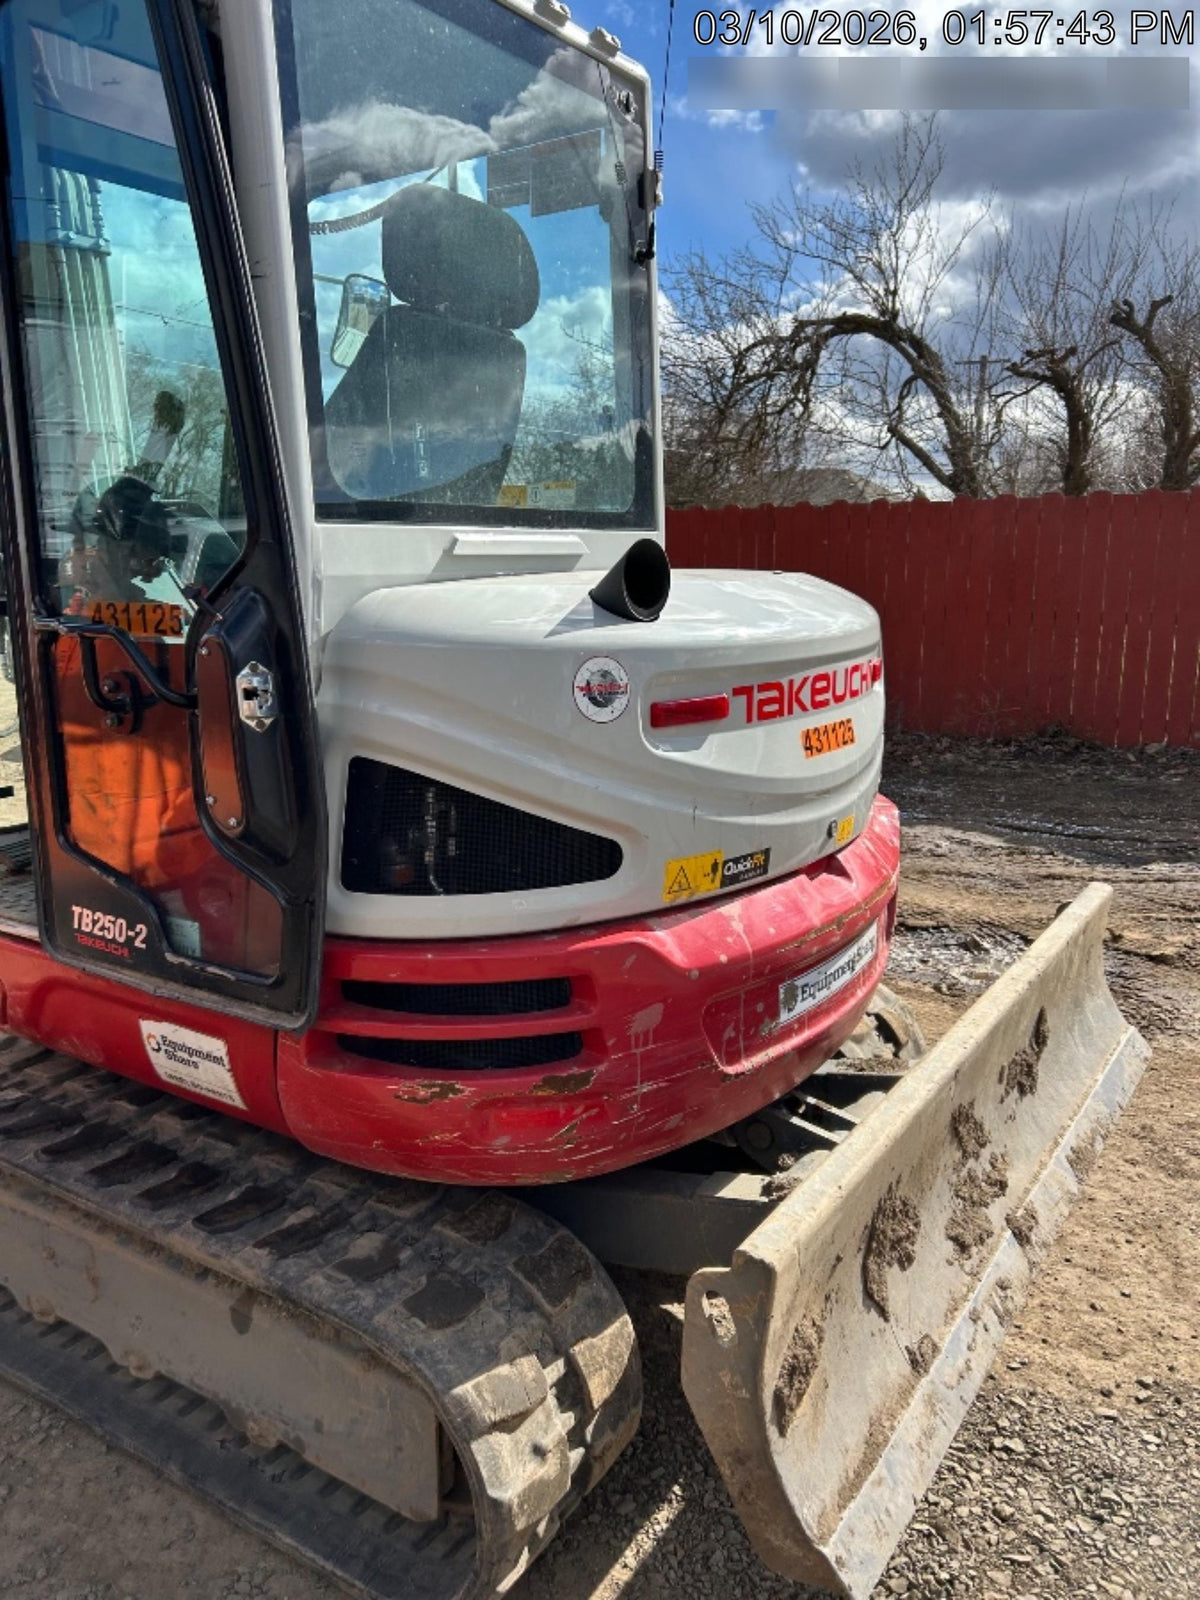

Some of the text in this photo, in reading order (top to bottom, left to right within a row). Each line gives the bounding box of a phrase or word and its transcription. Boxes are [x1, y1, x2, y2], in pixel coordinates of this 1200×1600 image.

[92, 602, 183, 635] 431125
[804, 718, 855, 755] 431125
[71, 904, 148, 949] TB250-2
[160, 1034, 226, 1068] Equipment
